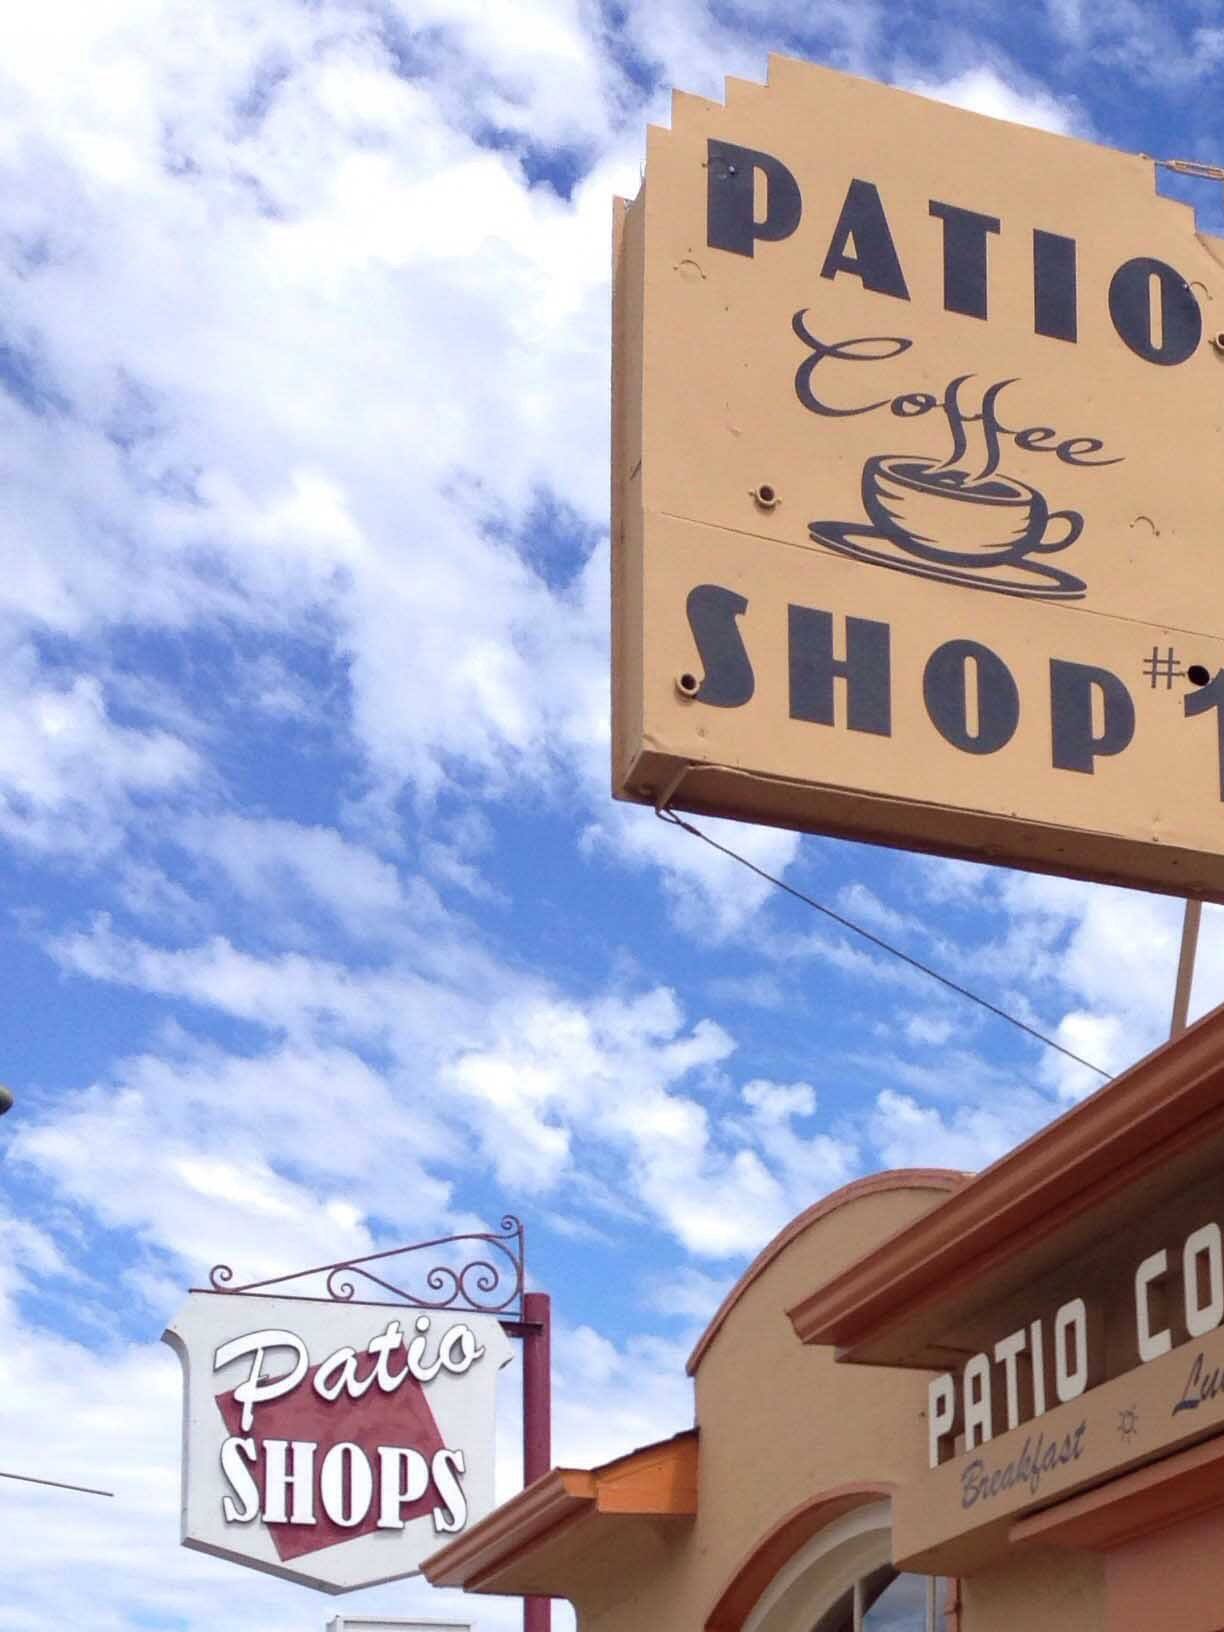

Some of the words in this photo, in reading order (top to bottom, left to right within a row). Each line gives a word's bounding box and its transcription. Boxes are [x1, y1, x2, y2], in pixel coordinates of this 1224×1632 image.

[707, 138, 1203, 367] PATIO
[792, 308, 1125, 479] Coffee
[685, 583, 1136, 776] SHOP
[213, 1315, 486, 1432] Patio
[928, 1297, 1088, 1469] PATIO
[220, 1436, 469, 1534] SHOPS
[960, 1421, 1087, 1509] Breakfast
